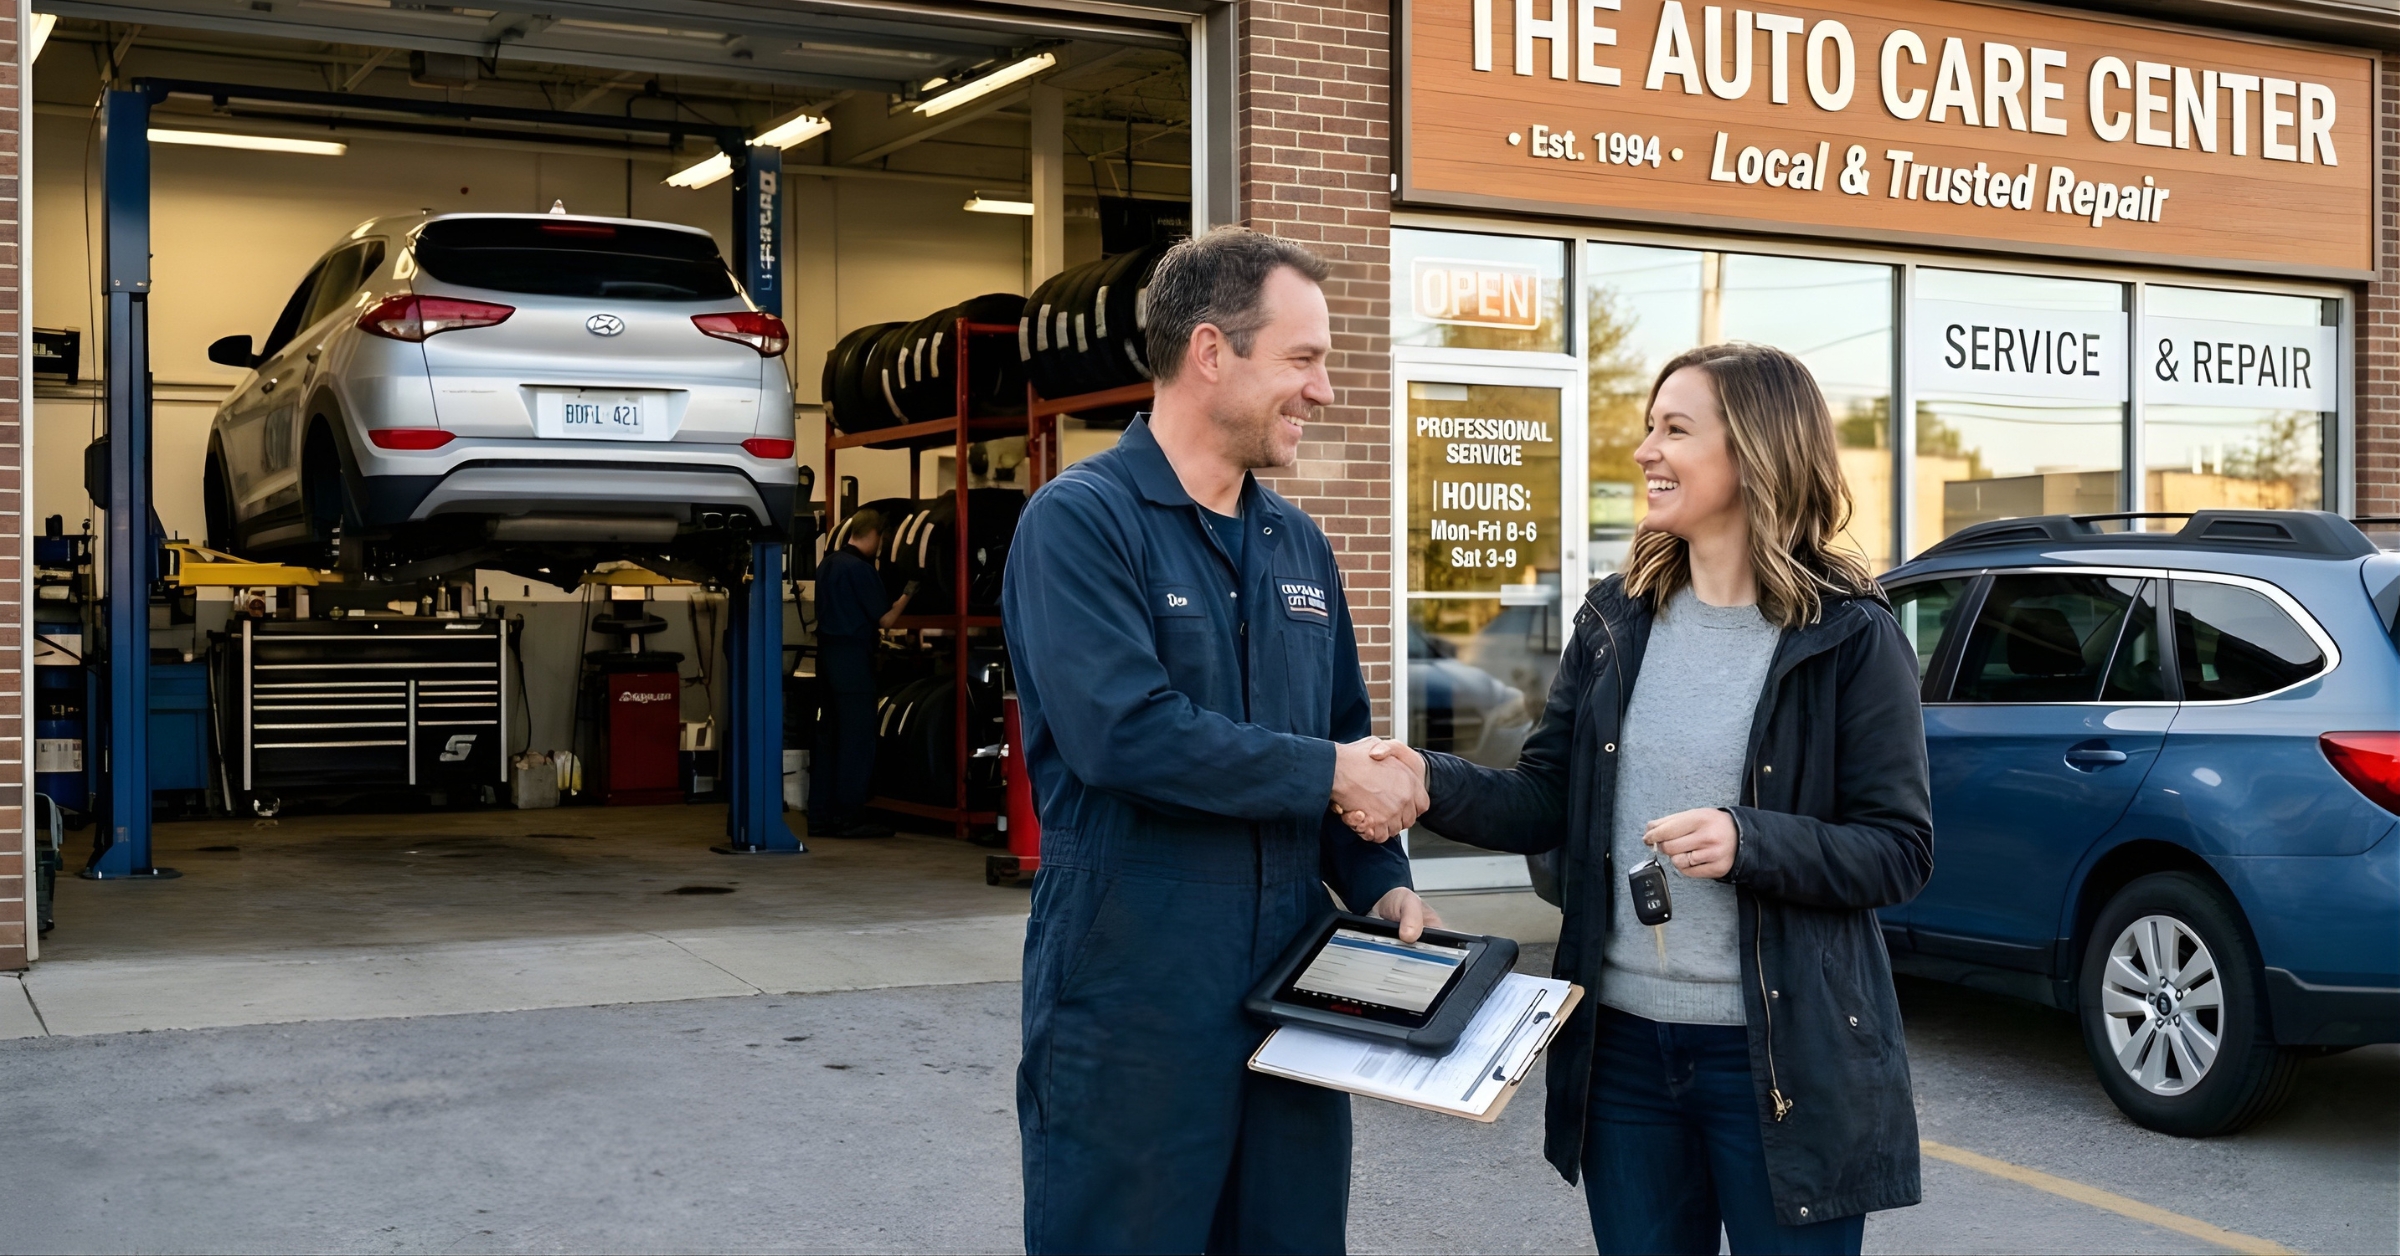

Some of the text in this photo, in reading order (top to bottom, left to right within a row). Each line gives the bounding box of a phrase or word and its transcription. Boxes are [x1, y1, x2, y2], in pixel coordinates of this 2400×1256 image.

[1645, 0, 1856, 112] AUTO
[1880, 29, 2067, 136] CARE
[2089, 56, 2338, 166] CENTER
[1532, 124, 1662, 169] Est. 1994
[1711, 131, 2170, 228] Local & Trusted Repair
[1422, 268, 1531, 318] OPEN
[1944, 324, 2100, 376] SERVICE
[2155, 338, 2312, 389] & REPAIR
[1416, 416, 1553, 442] PROFESSIONAL
[1446, 443, 1523, 466] SERVICE
[1442, 482, 1531, 511] HOURS:
[1431, 519, 1501, 541] Mon-Fri
[1451, 547, 1482, 568] Sat
